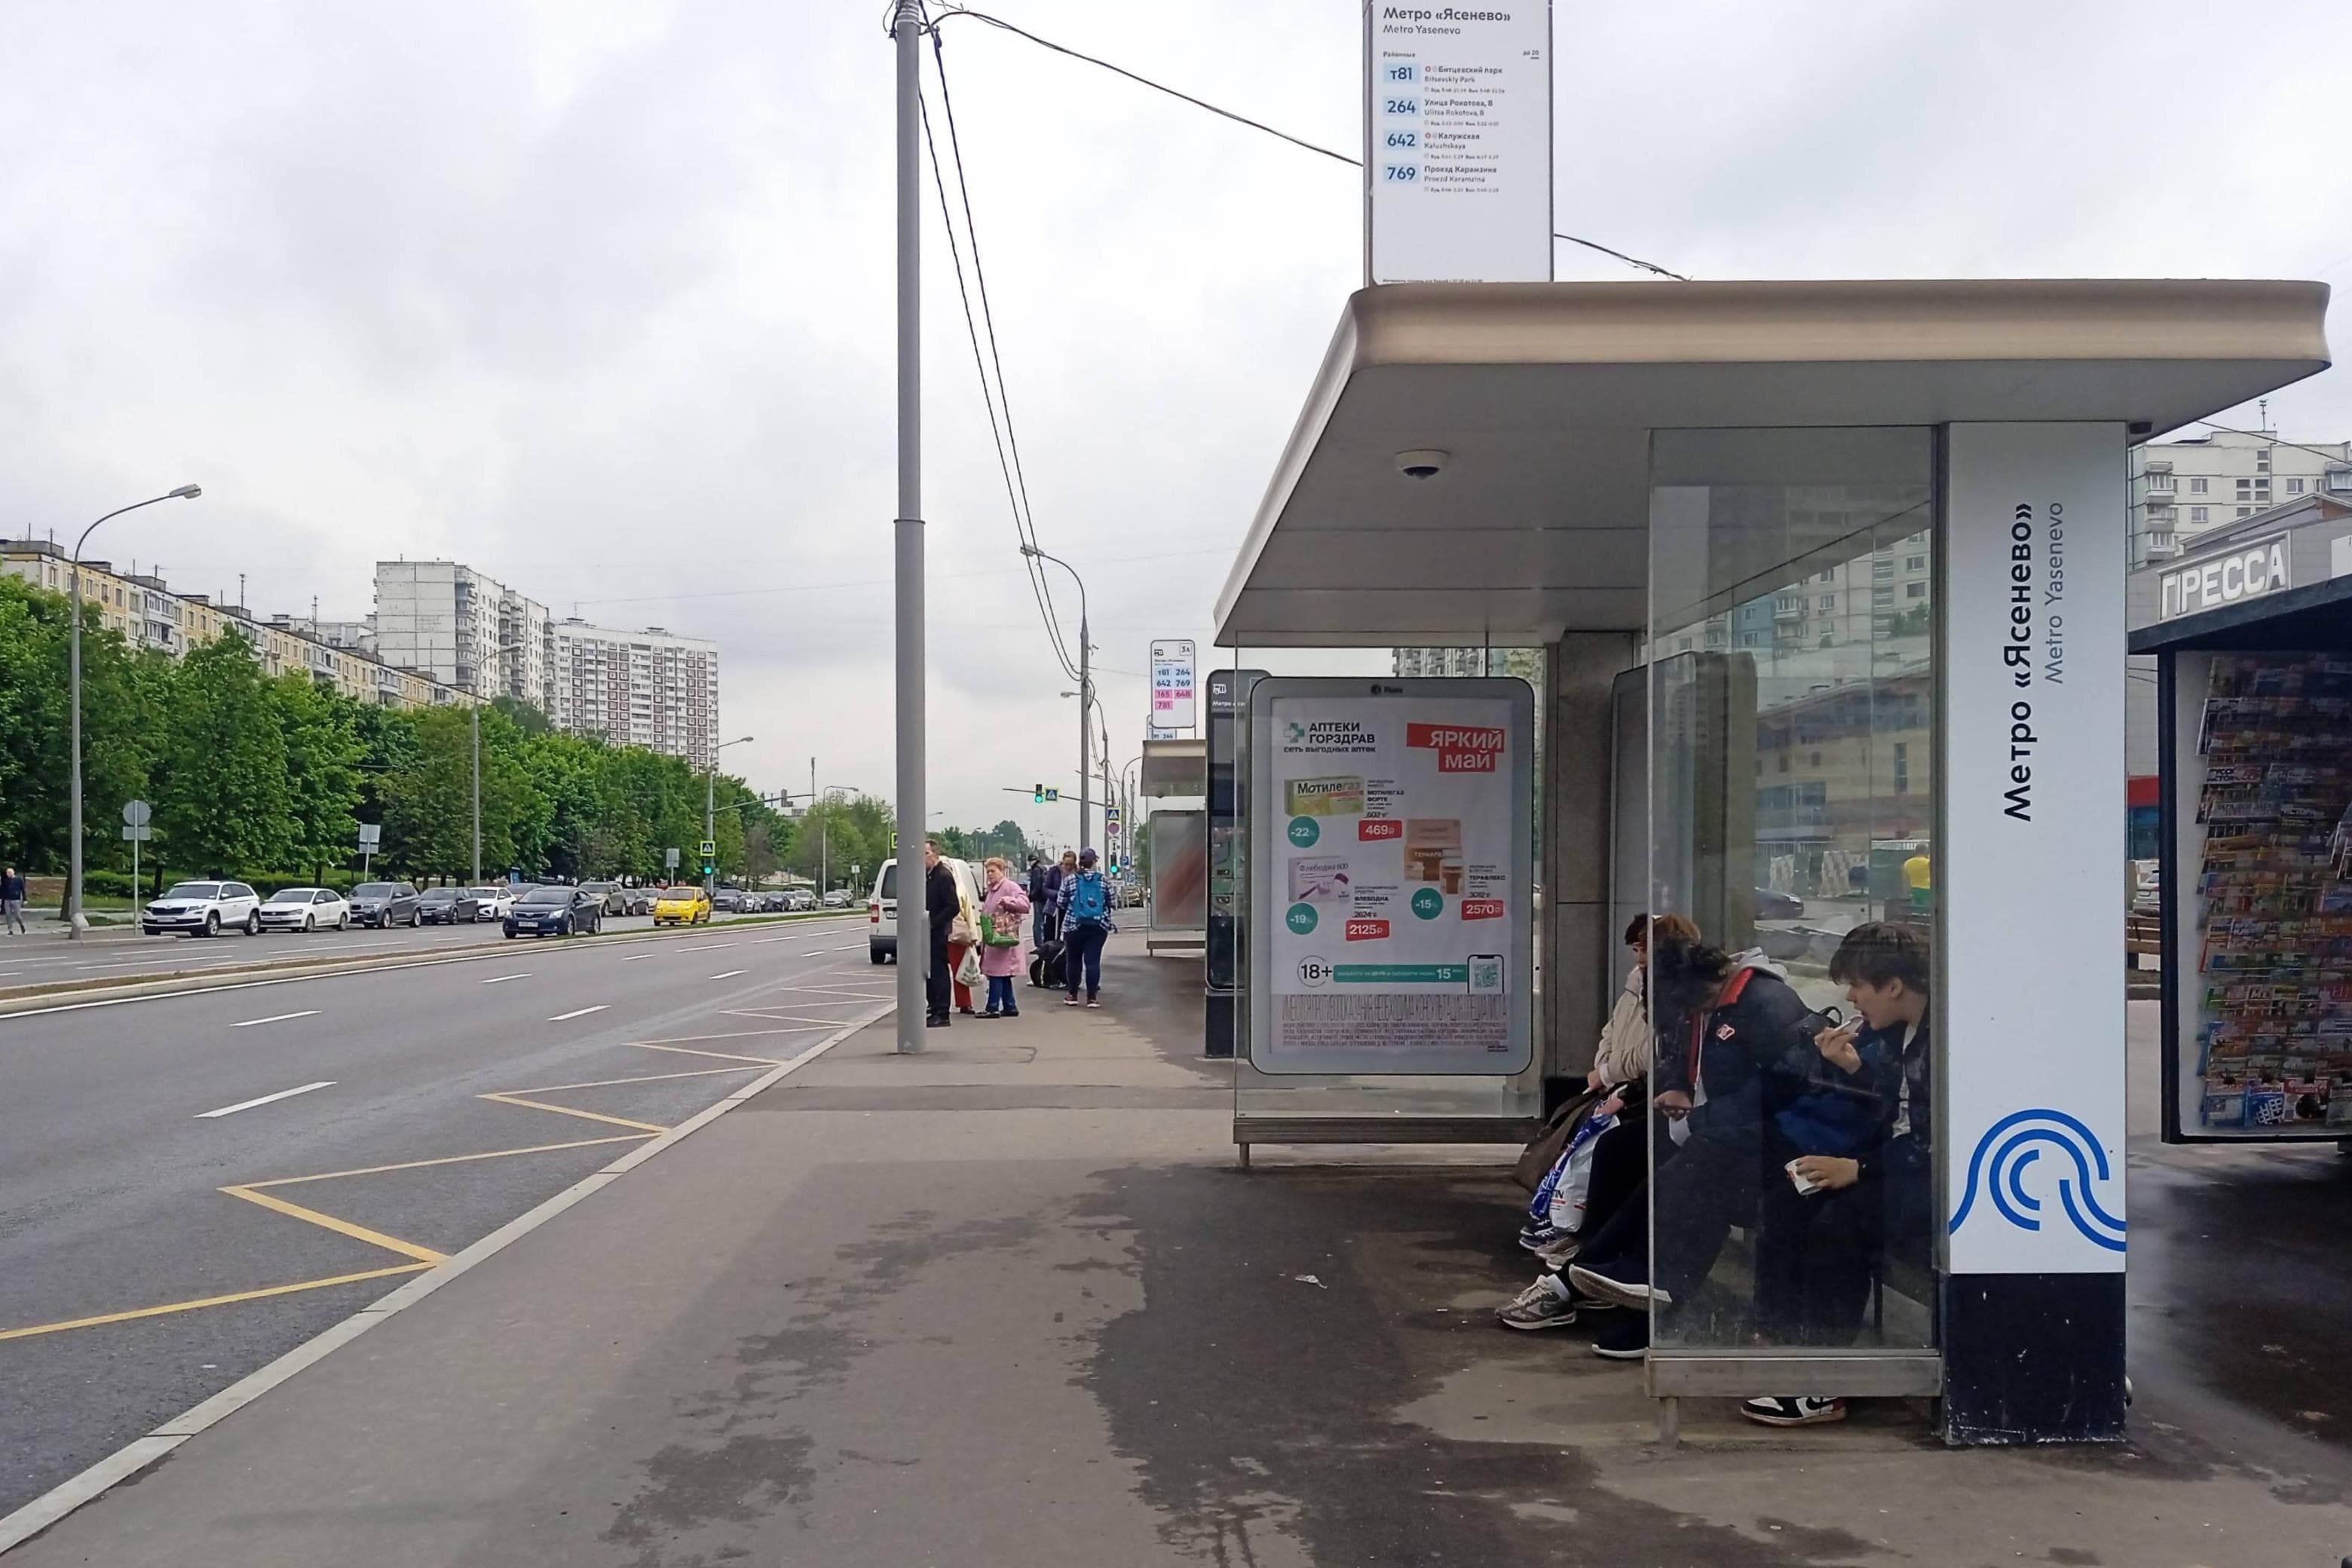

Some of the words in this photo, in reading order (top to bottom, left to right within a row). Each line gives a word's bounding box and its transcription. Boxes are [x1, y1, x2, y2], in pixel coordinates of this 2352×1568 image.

[1383, 7, 1432, 22] Метро
[1435, 8, 1511, 21] «Ясенево»
[1383, 25, 1413, 34] Metro
[1416, 25, 1461, 35] Yasenevo
[1390, 67, 1413, 80] т81
[1387, 100, 1416, 113] 264
[1425, 100, 1447, 108] Улица
[1387, 133, 1416, 147] 642
[1438, 133, 1480, 141] Калужская
[1387, 167, 1416, 180] 769
[2044, 502, 2063, 605] Yasenevo
[2161, 544, 2286, 618] ПРЕССА
[2004, 503, 2032, 688] «Ясенево»
[2044, 615, 2063, 684] Metro
[1309, 722, 1360, 732] АПТЕКИ
[1309, 734, 1375, 745] ГОРЗДРАВ
[1430, 729, 1502, 749] ЯРКИЙ
[1445, 750, 1490, 768] май
[2004, 701, 2038, 821] Метро
[1298, 782, 1360, 795] Мотилегаз
[1301, 964, 1332, 979] 18+
[1437, 968, 1451, 979] 15
